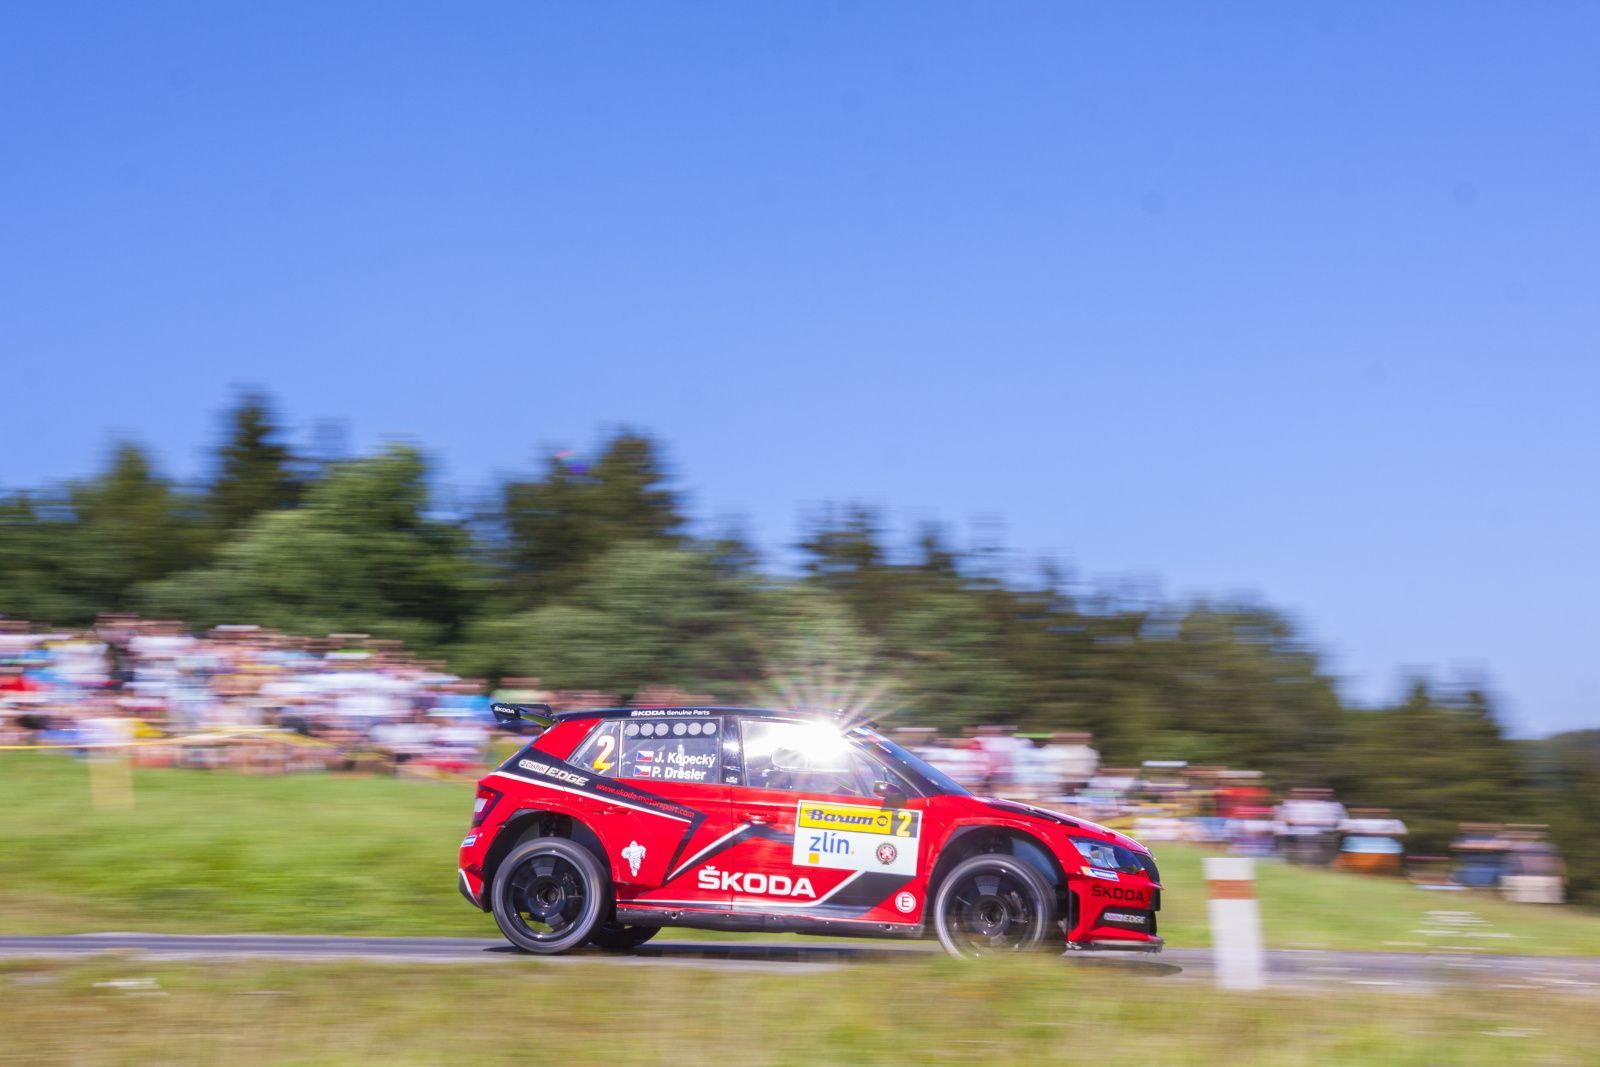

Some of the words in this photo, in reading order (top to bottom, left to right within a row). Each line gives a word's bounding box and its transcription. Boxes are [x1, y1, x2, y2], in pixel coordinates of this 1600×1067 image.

[592, 735, 616, 771] 2
[655, 752, 665, 763] J.
[667, 752, 716, 768] Kopecký
[545, 767, 590, 787] EDGE
[651, 766, 662, 780] P.
[664, 767, 707, 780] Dresler
[805, 809, 874, 826] Barum
[896, 806, 913, 837] 2
[697, 865, 817, 898] ŠKODA
[1091, 882, 1145, 903] ŠKODA
